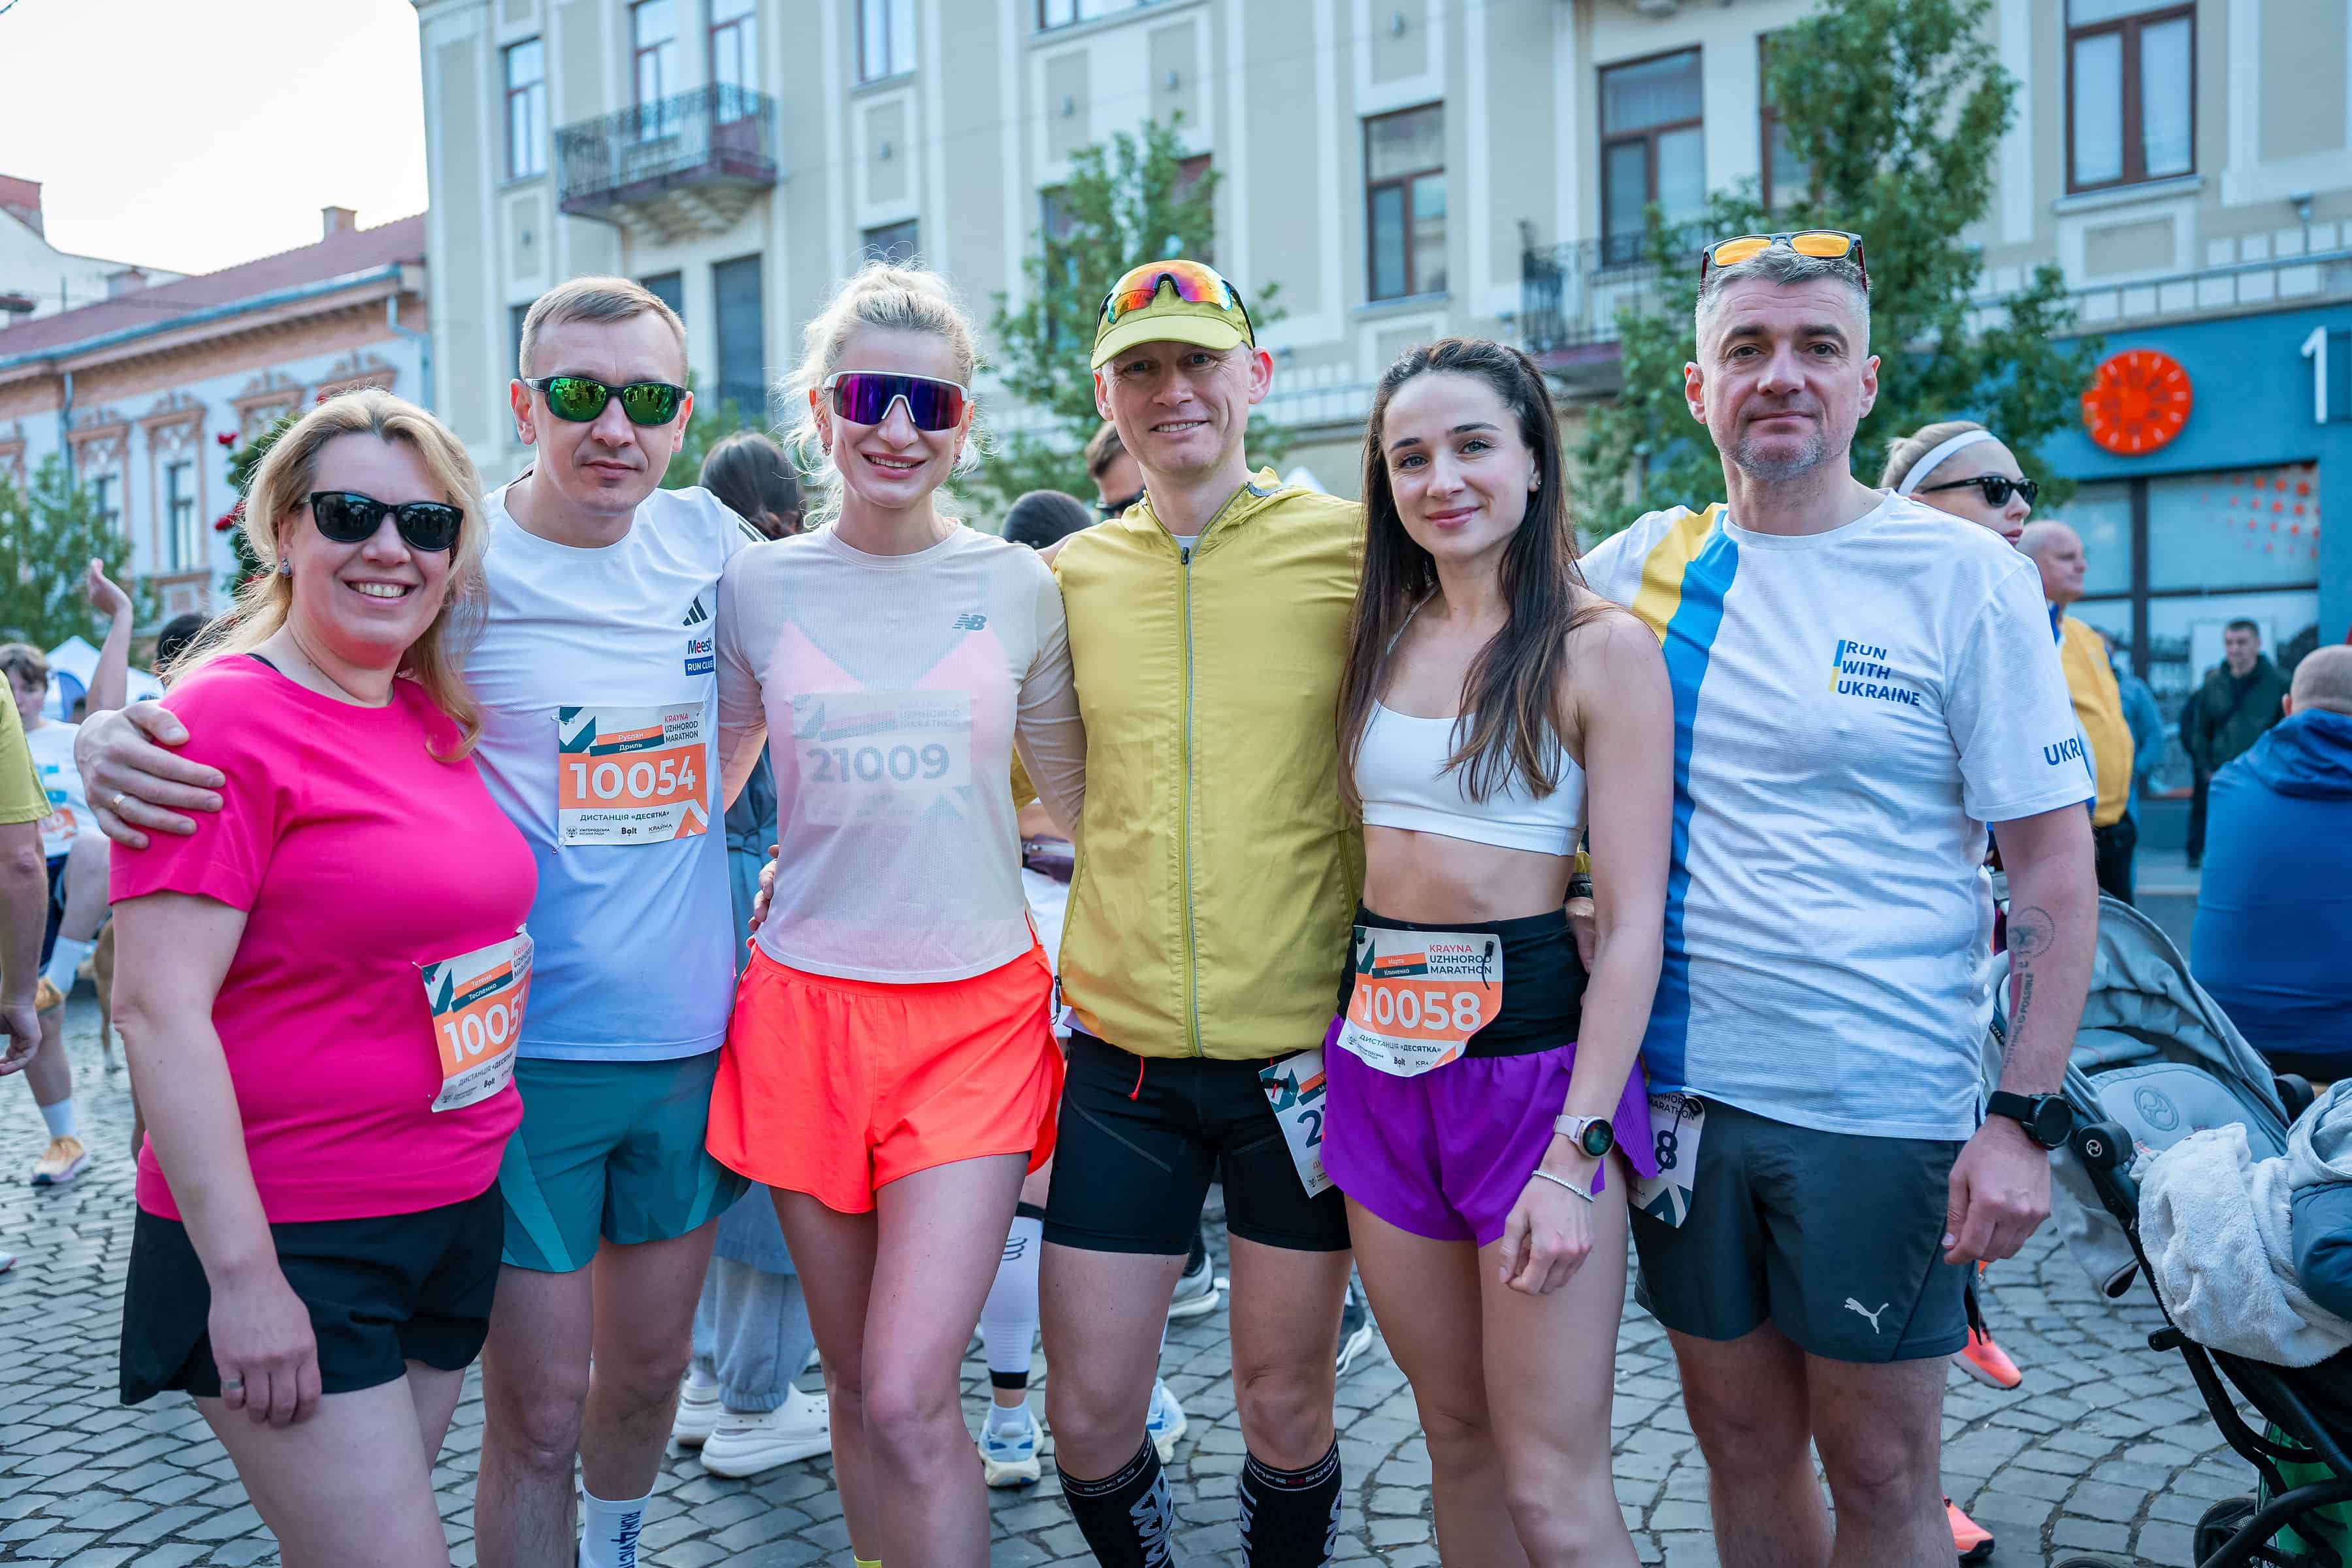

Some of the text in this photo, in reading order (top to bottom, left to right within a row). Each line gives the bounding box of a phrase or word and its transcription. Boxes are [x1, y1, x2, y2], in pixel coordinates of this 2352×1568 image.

[1846, 640, 1887, 661] RUN
[688, 662, 701, 672] RUN
[1842, 661, 1891, 679] WITH
[1838, 680, 1920, 706] UKRAINE
[664, 711, 689, 723] KRAYNA
[665, 721, 698, 732] UZHHOROD
[618, 732, 644, 742] Руслан
[666, 730, 698, 743] MARATHON
[2044, 738, 2081, 765] UKR
[806, 743, 950, 783] 21009
[569, 755, 696, 800] 10054
[621, 827, 637, 837] Bolt
[1431, 966, 1492, 974] MARATHON
[468, 983, 497, 1000] Тесленко
[1362, 984, 1482, 1032] 10058
[1359, 1034, 1441, 1053] ДИСТАНЦІЯ «ДЕСЯТКА»
[1394, 1056, 1405, 1068] Bolt
[484, 1077, 495, 1089] Bolt
[1652, 1098, 1694, 1121] ARATHON
[1297, 1104, 1326, 1148] 2
